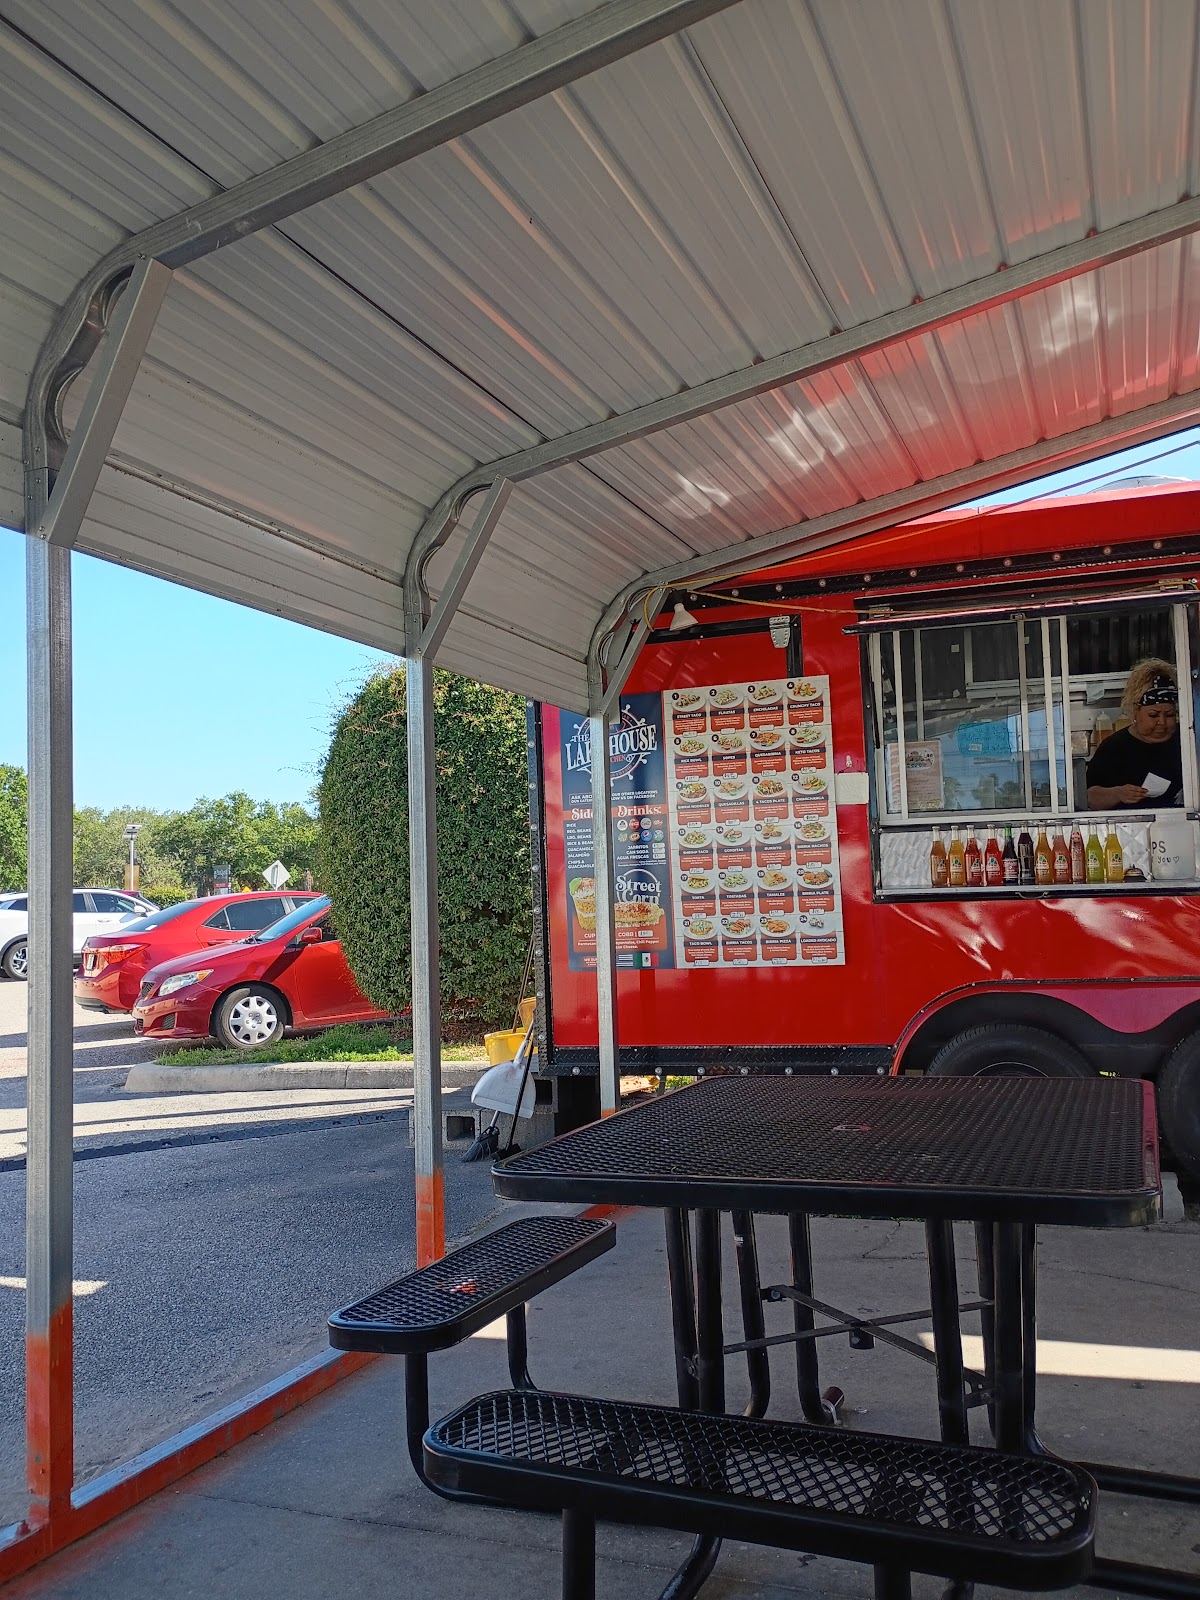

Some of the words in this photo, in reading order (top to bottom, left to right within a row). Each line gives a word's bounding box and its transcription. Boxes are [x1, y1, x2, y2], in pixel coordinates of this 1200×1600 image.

[571, 734, 591, 743] THE
[565, 725, 657, 770] LAHOUSE
[571, 808, 593, 821] Sid
[617, 804, 662, 818] Drinks
[616, 875, 662, 893] Street
